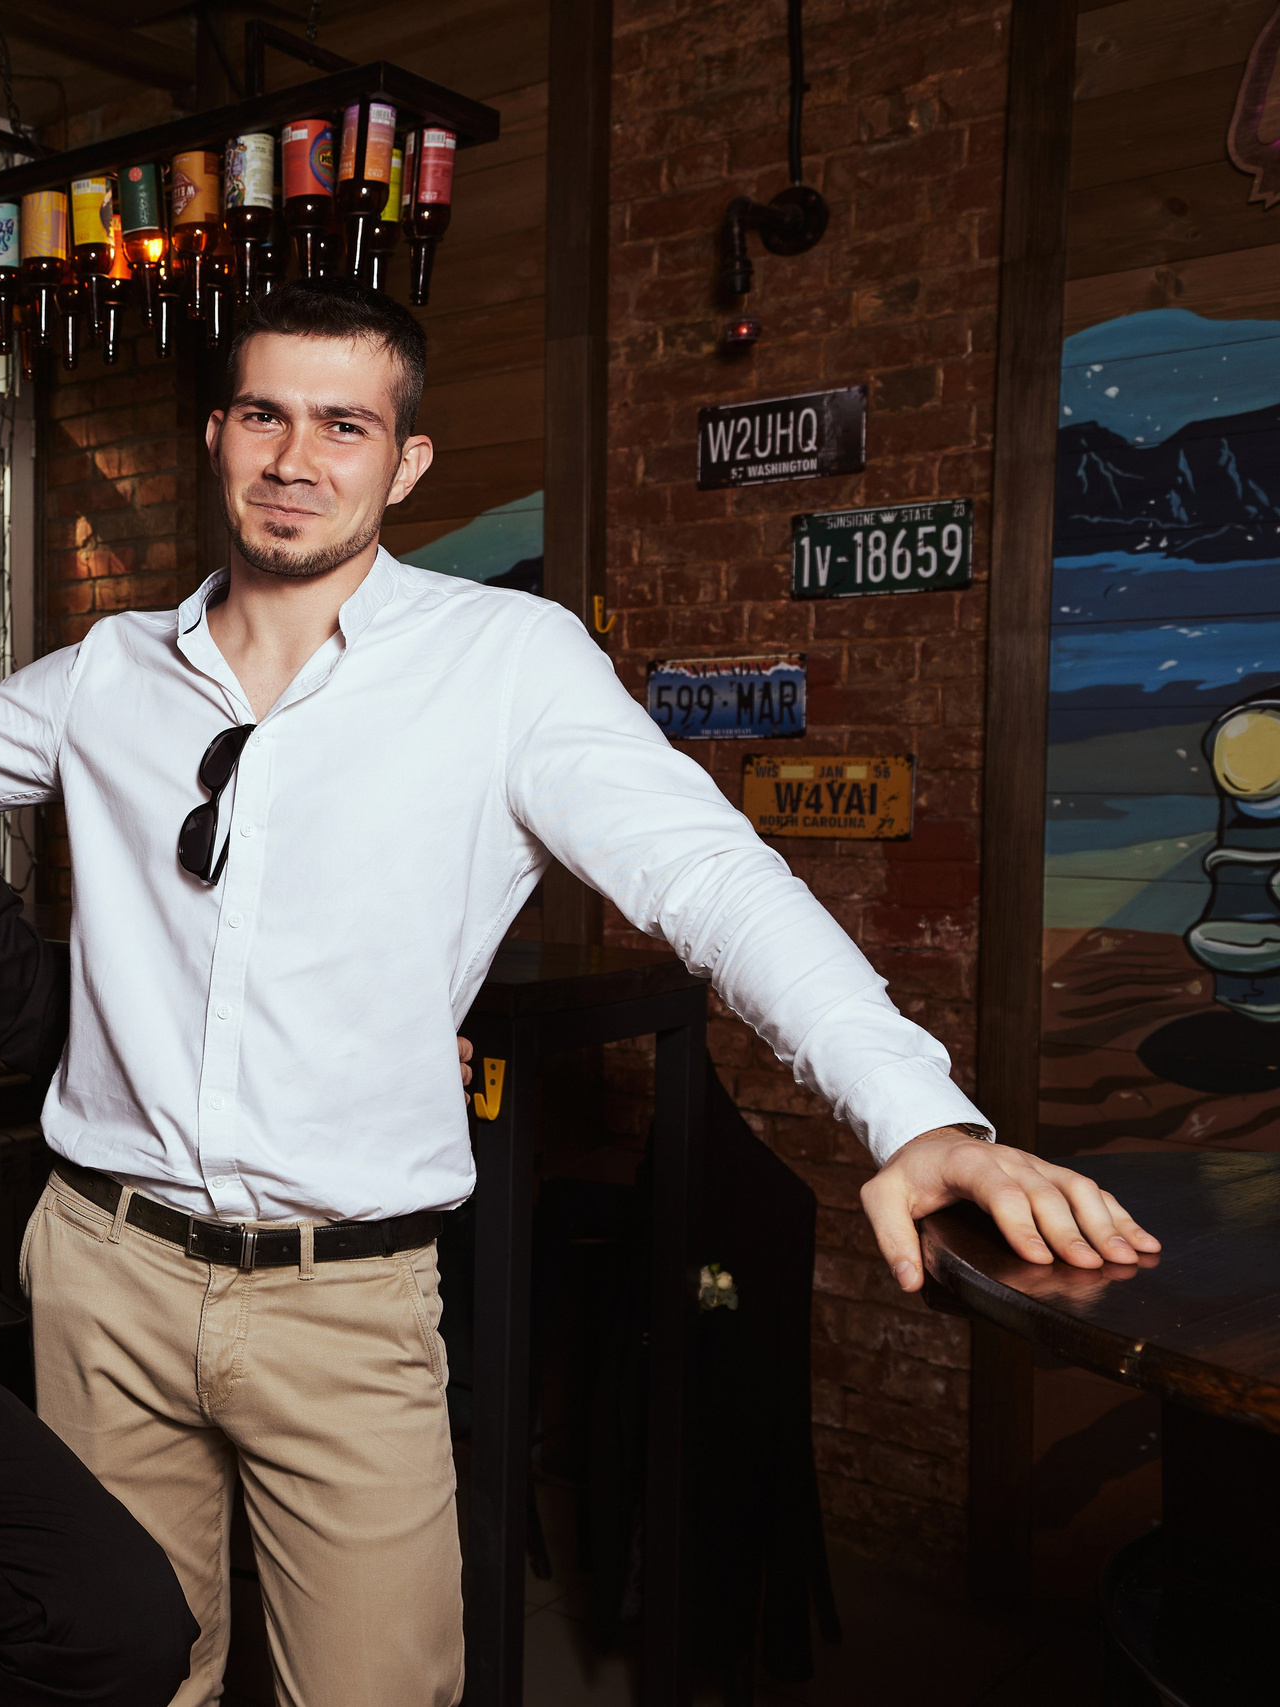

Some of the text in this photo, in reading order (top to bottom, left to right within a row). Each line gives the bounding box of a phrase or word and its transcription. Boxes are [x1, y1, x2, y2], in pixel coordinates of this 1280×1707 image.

[708, 407, 818, 463] W2UHQ
[747, 458, 818, 478] WASHINGTON
[901, 507, 934, 523] STATE
[820, 765, 844, 778] JAN
[759, 815, 866, 829] NORTH CAROLINA
